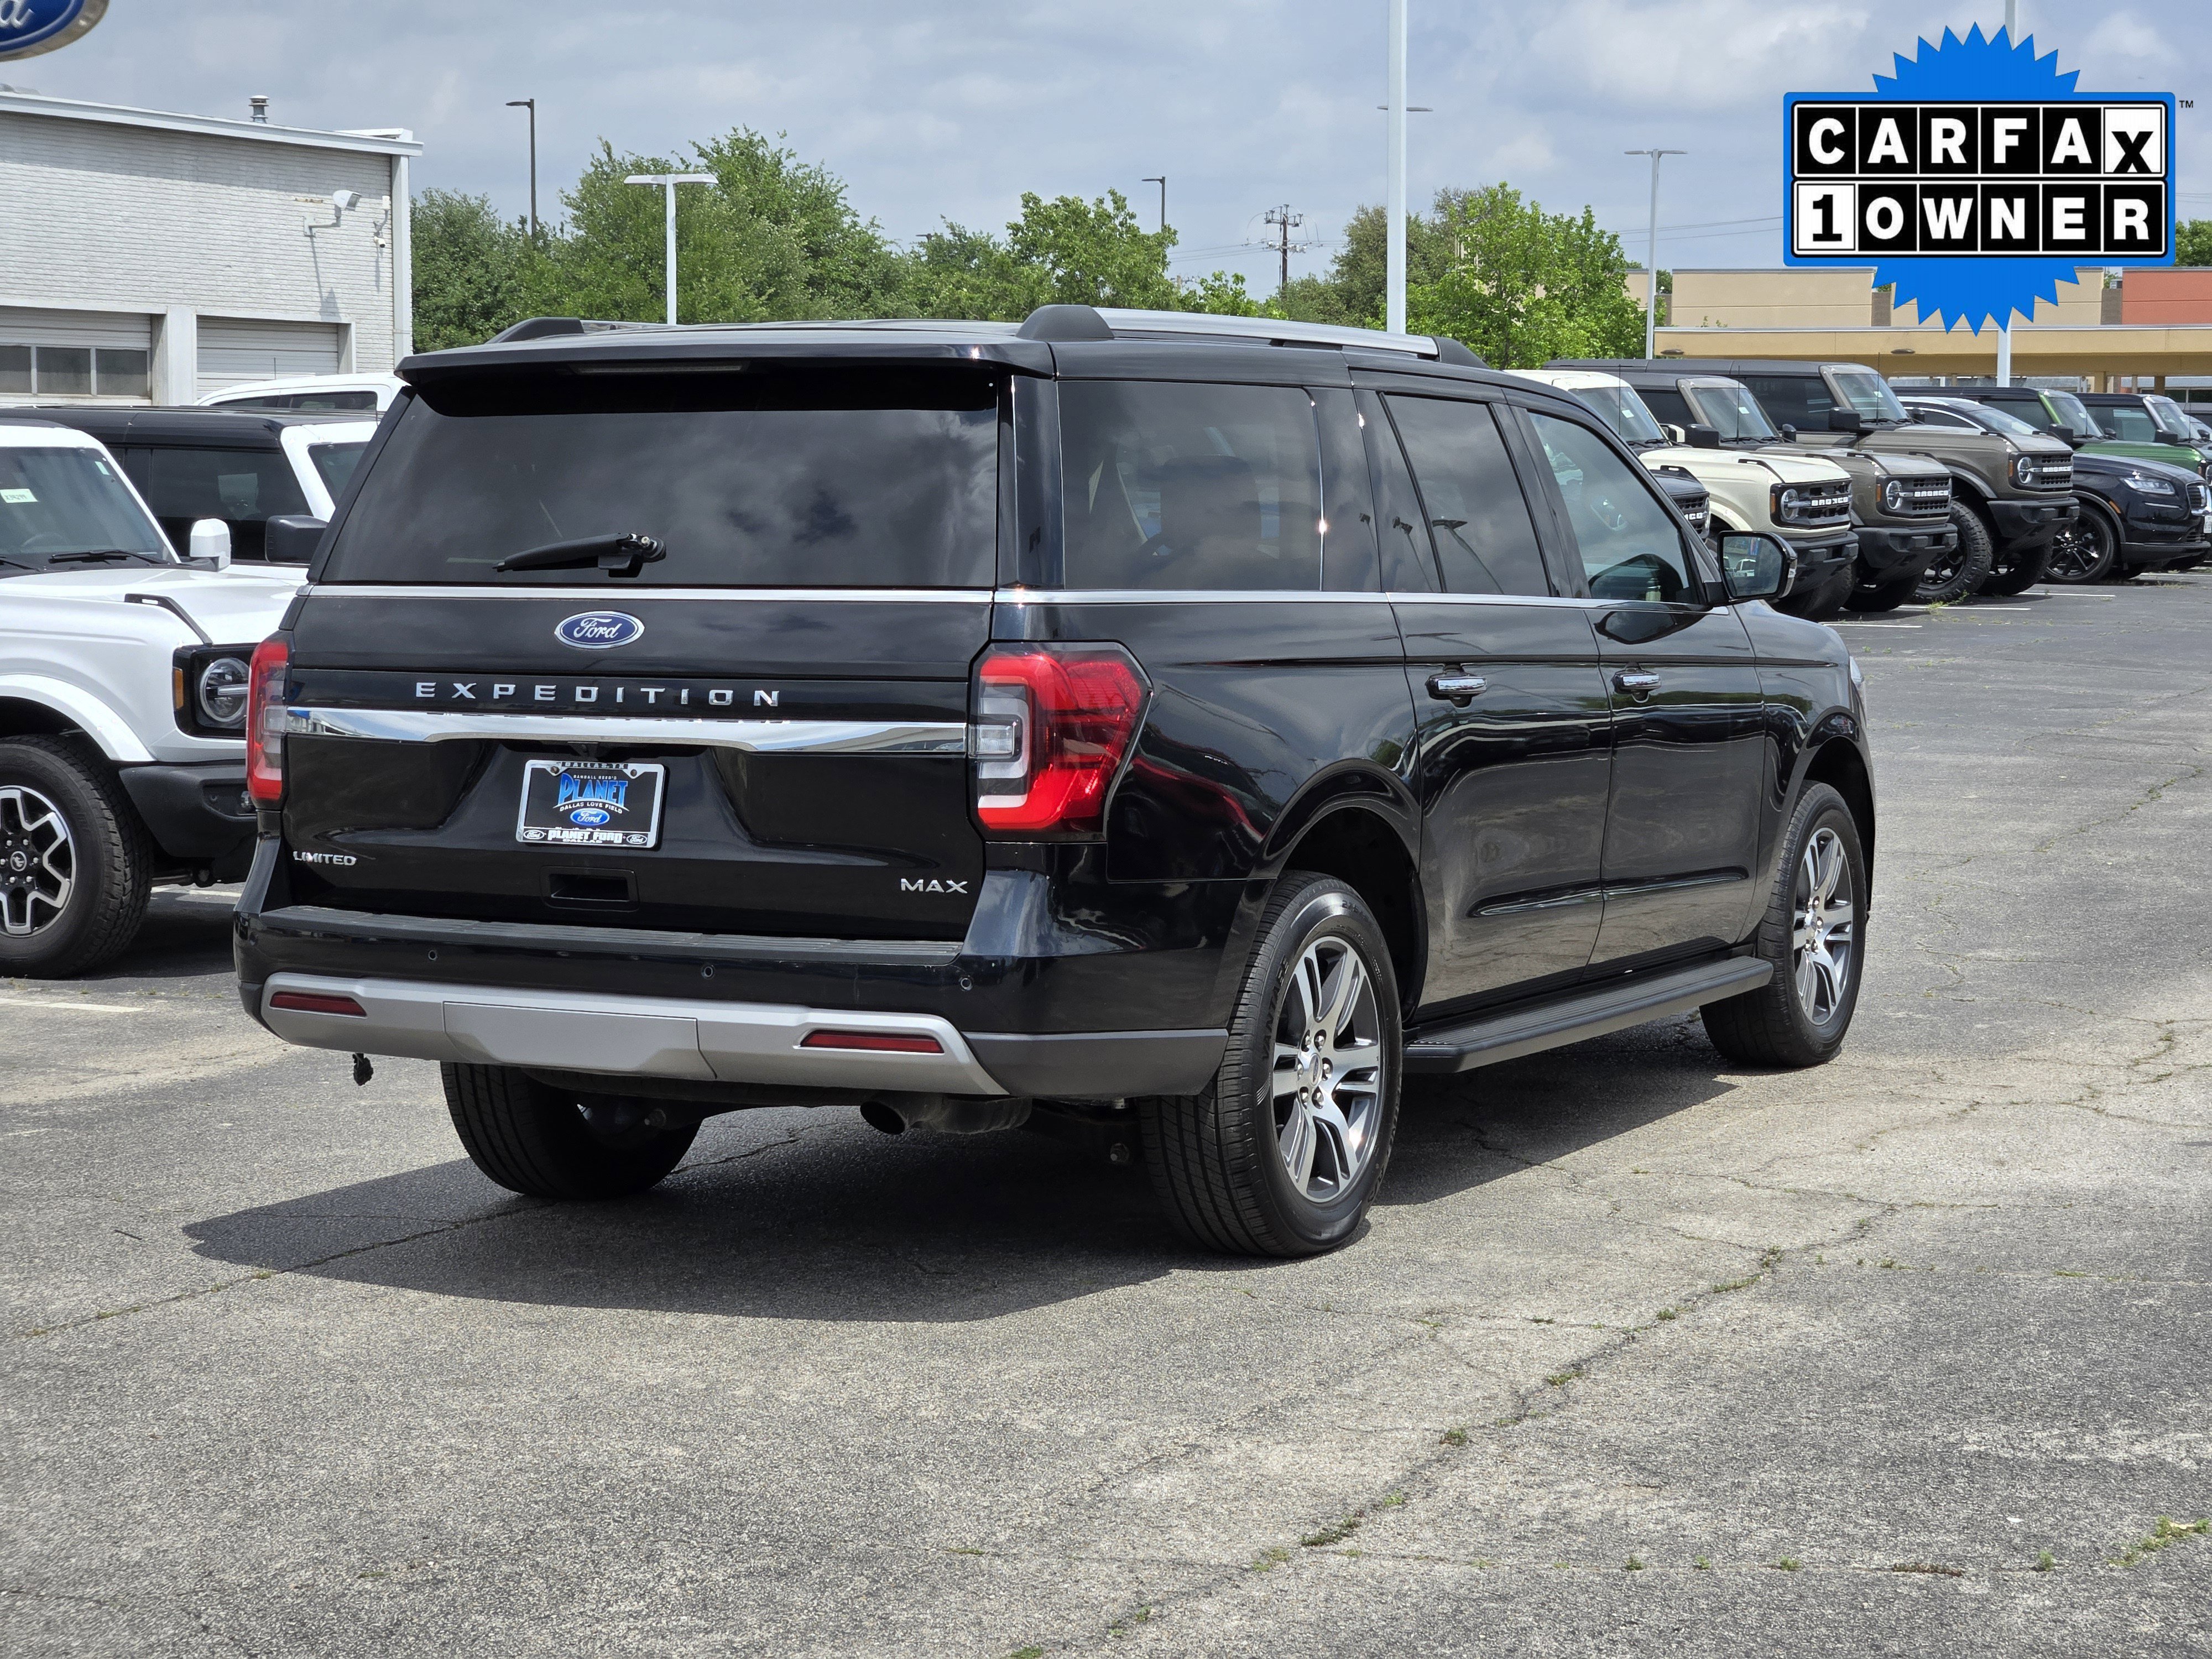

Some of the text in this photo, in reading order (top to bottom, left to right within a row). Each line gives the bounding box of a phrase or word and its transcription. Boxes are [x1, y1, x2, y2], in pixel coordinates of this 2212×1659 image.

[573, 617, 623, 639] Ford
[415, 682, 780, 707] EXPEDITION
[557, 773, 629, 807] PLANET
[559, 802, 584, 812] DALLAS
[604, 804, 623, 814] FIELD
[577, 810, 603, 823] Ford
[547, 830, 623, 843] PLANET FORD
[293, 851, 358, 866] LIMITED
[900, 878, 968, 894] MAX
